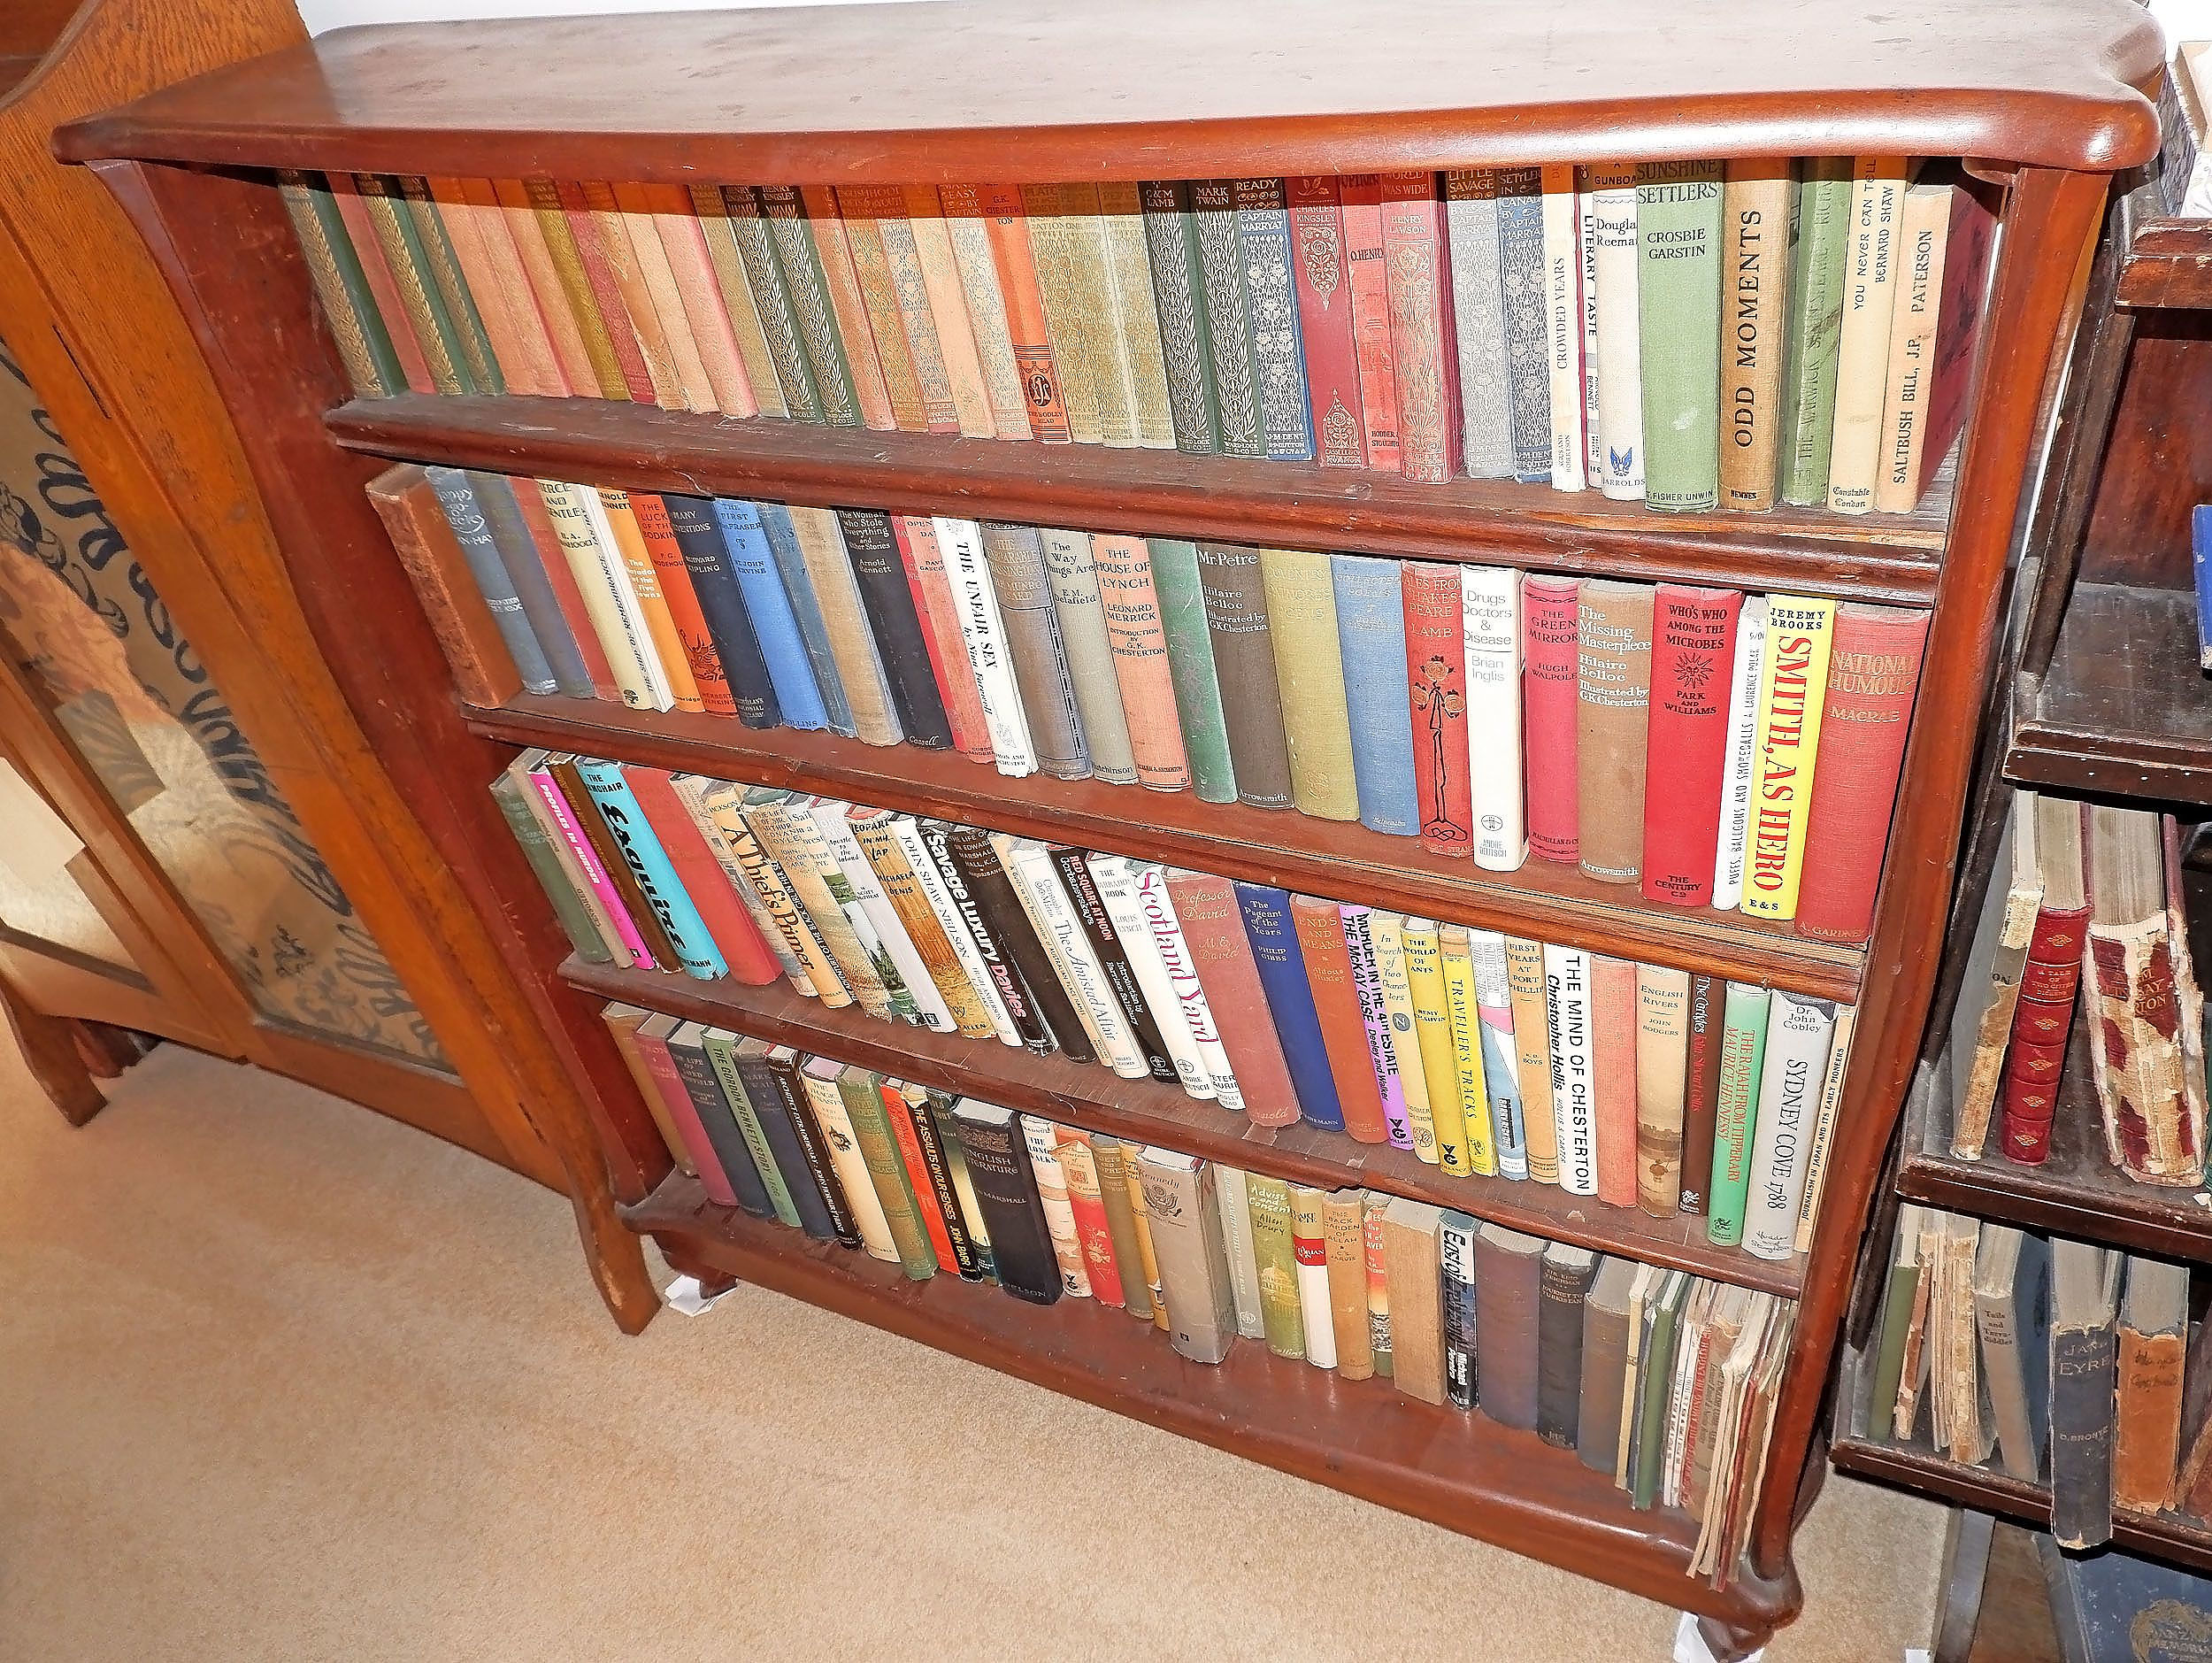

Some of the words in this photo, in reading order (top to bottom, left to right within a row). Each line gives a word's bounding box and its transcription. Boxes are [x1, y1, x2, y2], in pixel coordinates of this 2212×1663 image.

[1196, 188, 1229, 196] MARK
[1237, 179, 1278, 191] READY
[1404, 184, 1428, 195] WIDE
[1449, 180, 1494, 191] SAVAGE
[1196, 196, 1229, 205] TWAIN
[1637, 182, 1717, 204] SETTLERS
[1147, 198, 1175, 207] LAMB
[1881, 186, 1894, 223] SHAW
[1240, 212, 1282, 222] CAPTAIN
[1296, 214, 1336, 223] KINGSLEY
[1391, 214, 1423, 224] HENRY
[1861, 198, 1873, 227] CAN
[1240, 221, 1283, 232] MARRYAT
[1389, 225, 1427, 235] LAWSON
[1647, 228, 1707, 243] CROSBIE
[1648, 244, 1707, 259] GARSTIN
[1856, 234, 1870, 276] NEVER
[1875, 228, 1890, 283] BERNARD
[1910, 230, 1932, 313] PATERSON
[1554, 258, 1565, 303] YEARS
[1736, 210, 1763, 368] MOMENTS
[1854, 285, 1865, 310] YOU
[1587, 296, 1596, 336] TASTE
[1557, 306, 1568, 370] CROWDED
[1902, 364, 1921, 402] BILL,
[1734, 386, 1755, 448] ODD
[1893, 410, 1914, 484] SALTBUSH
[1685, 490, 1713, 501] UNWIN
[1833, 487, 1870, 497] Constable
[641, 512, 668, 522] LUCK
[721, 512, 749, 521] FIRST
[860, 519, 883, 527] Stole
[865, 542, 891, 550] Stories
[1051, 542, 1071, 551] The
[1053, 553, 1078, 565] Way
[1106, 550, 1131, 559] THE
[859, 558, 886, 567] Arnold
[1095, 563, 1133, 575] HOUSE
[1134, 562, 1150, 573] OF
[1102, 578, 1150, 589] LYNCH
[1203, 586, 1244, 598] Hilaire
[1467, 589, 1506, 605] Drugs
[957, 542, 974, 574] THE
[966, 580, 989, 635] UNFAIR
[980, 641, 998, 669] SEX
[1108, 604, 1152, 612] LEONARD
[1205, 597, 1244, 610] Belloc
[1409, 604, 1454, 618] PEARE
[1107, 612, 1156, 622] MERRICK
[1207, 610, 1253, 624] Illustrated
[1253, 612, 1267, 625] by
[1462, 604, 1513, 619] Doctors
[1669, 604, 1700, 620] WHO'S
[1701, 609, 1728, 620] WHO
[1770, 607, 1826, 620] JEREMY
[1410, 622, 1453, 637] LAMB
[1480, 620, 1492, 631] &
[1531, 616, 1577, 631] GREEN
[1578, 620, 1635, 642] Missing
[1667, 620, 1702, 634] AMONG
[1704, 624, 1725, 634] THE
[1771, 618, 1823, 630] BROOKS
[1463, 629, 1512, 646] Disease
[1529, 628, 1578, 643] MIRROR
[1665, 634, 1725, 650] MICROBES
[1578, 633, 1653, 655] Masterpiece
[1111, 647, 1166, 658] CHESTERTON
[1471, 655, 1504, 669] Brian
[1538, 663, 1570, 672] HUGH
[1578, 653, 1628, 670] Hilaire
[1830, 650, 1920, 675] NATIONAL
[1472, 669, 1505, 683] Inglis
[1531, 669, 1578, 681] WALPOLE
[1578, 666, 1626, 682] Belloc
[1676, 690, 1706, 701] PARK
[1763, 635, 1812, 753] SMITH,
[1663, 702, 1717, 715] WILLIAMS
[909, 735, 940, 747] Cassell
[588, 774, 603, 782] THE
[1762, 756, 1797, 802] AS
[1238, 789, 1288, 804] Arrowsmith
[1736, 784, 1747, 804] AND
[541, 784, 570, 831] PROFILES
[575, 845, 601, 885] MURDER
[1732, 808, 1746, 853] BALLOONS
[1754, 807, 1792, 892] HERO
[1580, 858, 1639, 878] Arrowsmith
[602, 802, 687, 950] Esquire
[889, 887, 914, 896] DENIS
[1105, 889, 1126, 898] BOOK
[1655, 880, 1702, 892] CENTURY
[720, 825, 750, 848] A
[772, 908, 814, 970] Primer
[901, 835, 926, 867] JOHN
[938, 907, 970, 959] NEILSON
[1069, 855, 1084, 874] RED
[1096, 915, 1115, 942] NOON
[1173, 889, 1232, 905] Professor
[1182, 901, 1231, 921] David
[1245, 906, 1282, 920] Pageant
[926, 834, 970, 901] Savage
[991, 963, 1027, 1019] Davies
[1297, 915, 1338, 928] ENDS
[1253, 926, 1282, 936] Years
[1134, 871, 1196, 982] Scotland
[1179, 986, 1219, 1044] Yard
[1257, 945, 1286, 955] PHILIP
[1403, 947, 1437, 957] WORLD
[1260, 954, 1287, 963] GIBBS
[1508, 953, 1541, 963] YEARS
[1342, 915, 1359, 942] THE
[1357, 989, 1375, 1023] CASE
[1384, 967, 1402, 979] Two
[1566, 956, 1581, 992] THE
[1513, 975, 1540, 984] PORT
[1640, 984, 1685, 999] ENGLISH
[1642, 997, 1679, 1009] RIVERS
[1547, 974, 1562, 1057] Christopher
[1568, 1000, 1584, 1047] MIND
[1783, 1021, 1821, 1034] Cobley
[1451, 979, 1472, 1064] TRAVELLER'S
[1462, 1069, 1478, 1120] TRACKS
[1552, 1051, 1564, 1091] Hollis
[1570, 1055, 1586, 1077] OF
[1777, 1059, 1809, 1132] SYDNEY
[720, 1066, 744, 1102] GORDON
[736, 1103, 759, 1146] BENNETT
[752, 1145, 772, 1174] STORY
[1571, 1082, 1590, 1190] CHESTERTON
[1801, 1181, 1816, 1221] JOURNALISM
[1830, 1048, 1845, 1083] PIONEERS
[1727, 1126, 1746, 1184] TIPPERARY
[1771, 1133, 1798, 1179] COVE
[1139, 1170, 1180, 1190] Kennedy
[1763, 1182, 1788, 1210] 1788
[1248, 1197, 1291, 1214] Consent
[1259, 1213, 1284, 1227] Allen
[1324, 1221, 1360, 1231] GARDEN
[940, 1190, 956, 1221] SENSES
[956, 1244, 972, 1267] BARR
[1256, 1220, 1285, 1236] Drury
[2060, 1356, 2111, 1375] EYRE
